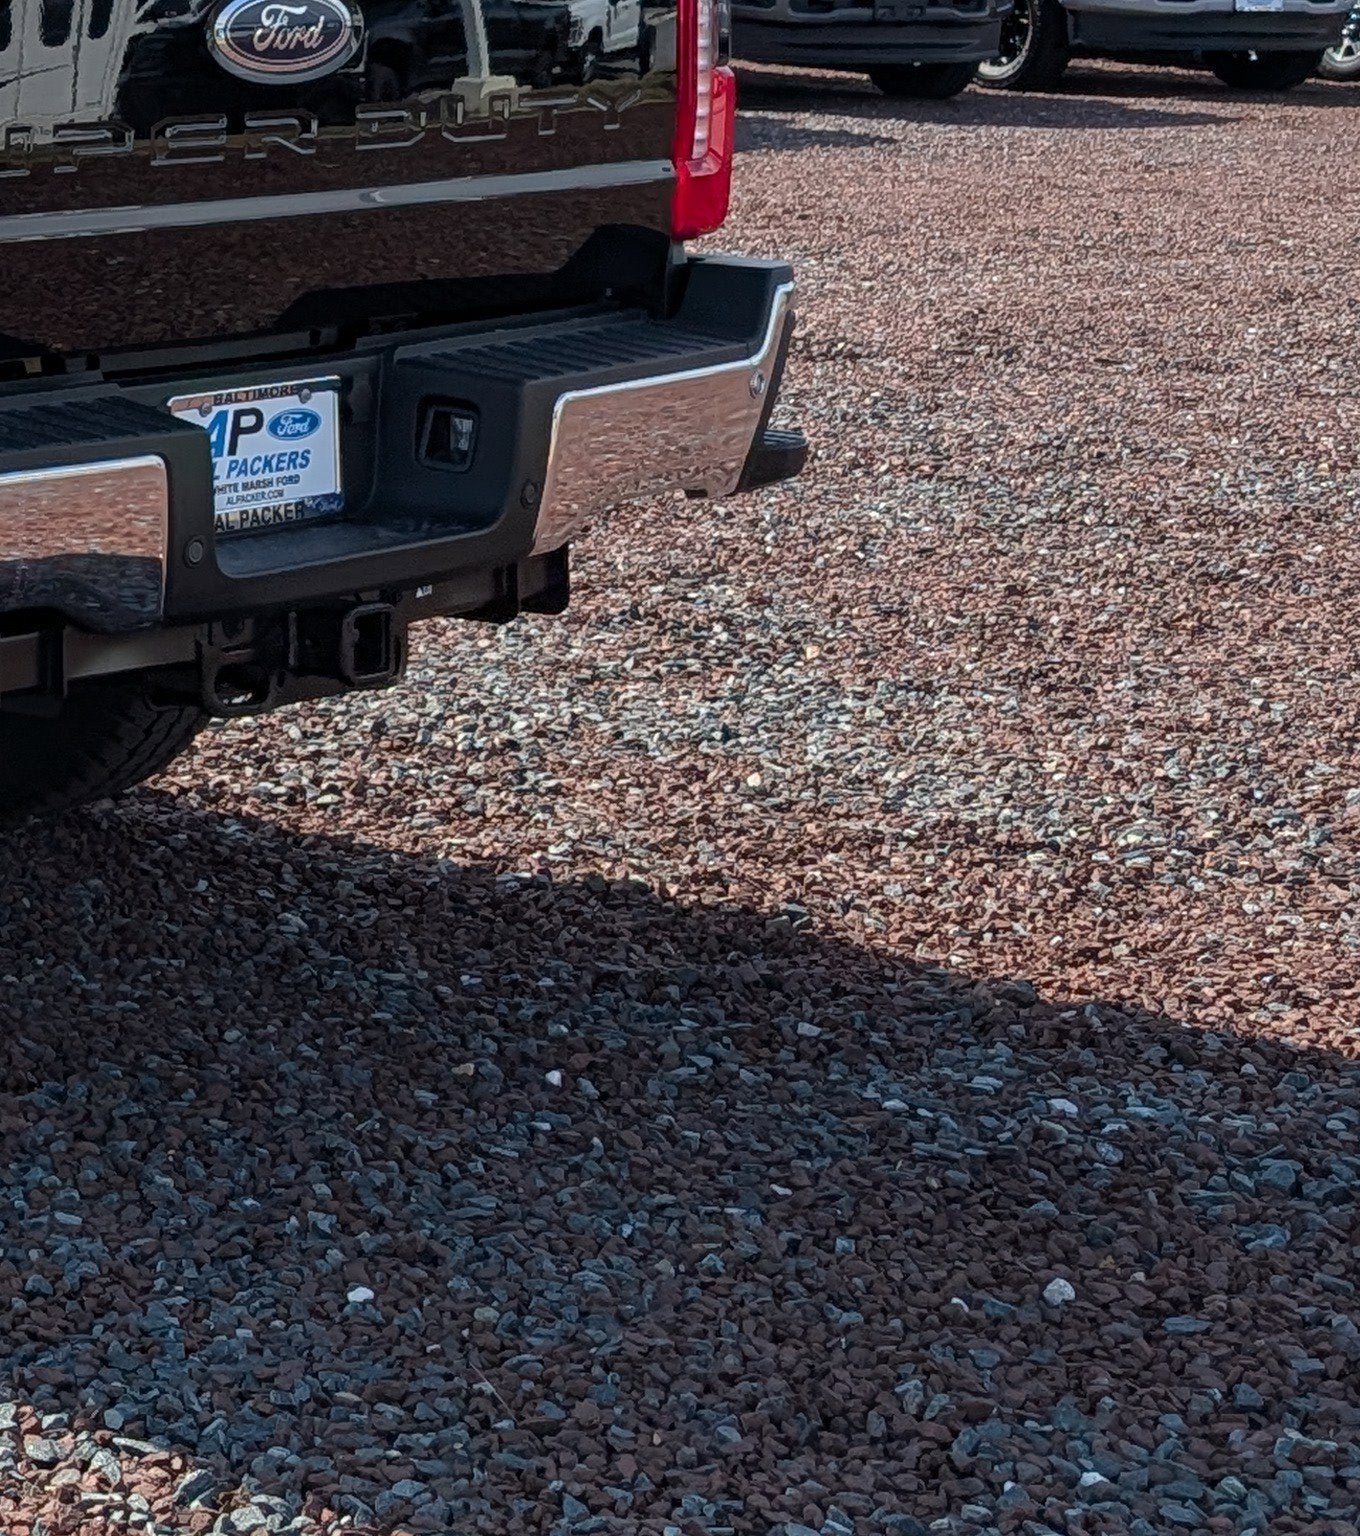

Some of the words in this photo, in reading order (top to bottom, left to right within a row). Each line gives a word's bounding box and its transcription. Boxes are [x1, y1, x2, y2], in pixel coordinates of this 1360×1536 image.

[252, 3, 326, 52] Ford
[355, 88, 642, 152] DUTY
[213, 384, 299, 406] BALTIMORE
[276, 414, 312, 436] Ford
[226, 449, 311, 480] PACKERS
[241, 477, 274, 492] MARSH
[276, 473, 301, 487] FORD
[214, 512, 235, 532] AL
[239, 500, 306, 529] PACKER
